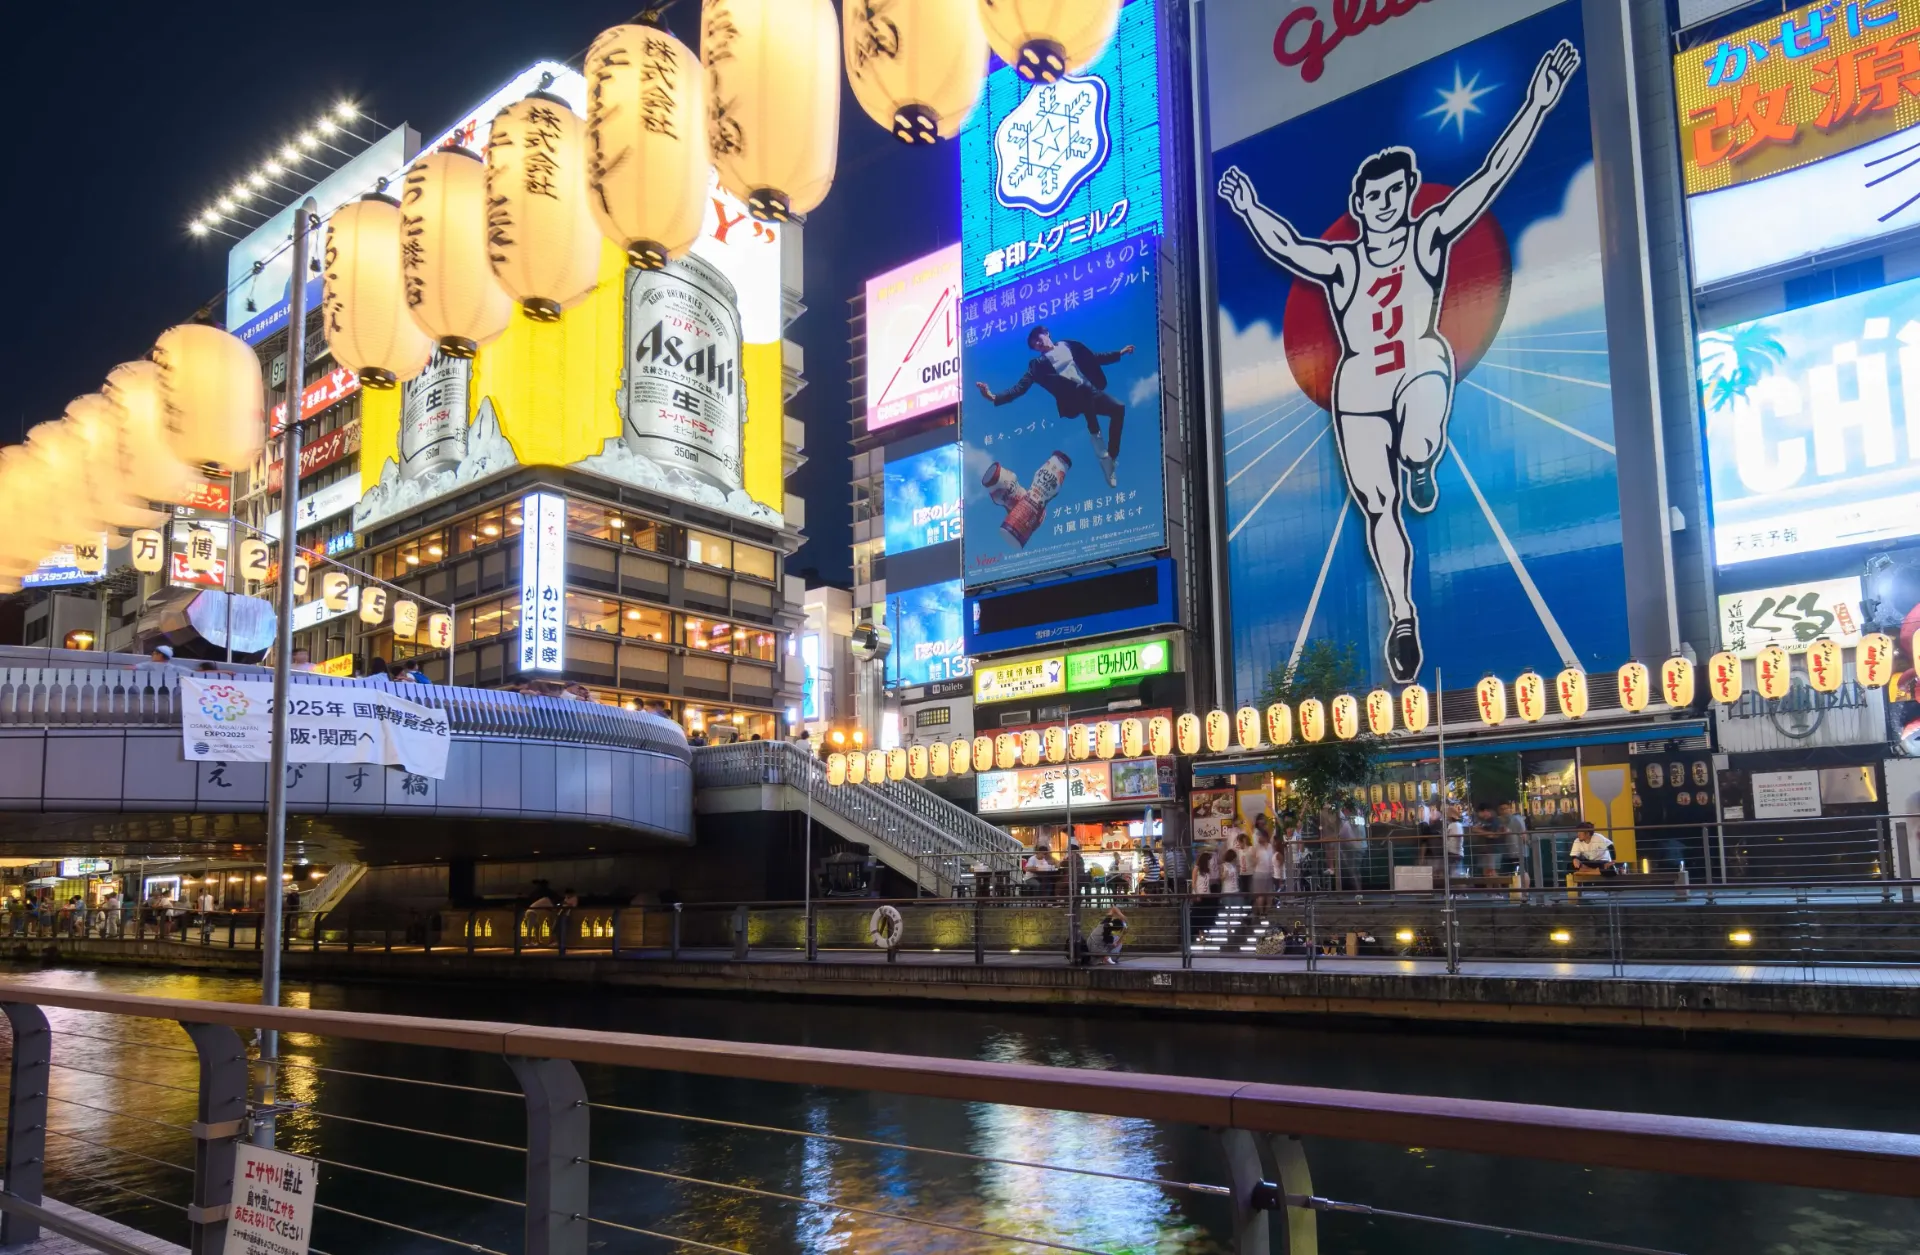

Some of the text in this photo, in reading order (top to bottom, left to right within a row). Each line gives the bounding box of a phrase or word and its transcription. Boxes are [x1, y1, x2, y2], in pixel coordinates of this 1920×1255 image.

[1703, 0, 1899, 87] かぜに
[641, 37, 680, 140] 株式会社
[1688, 28, 1920, 168] 改源
[526, 106, 561, 200] 株式会社
[983, 199, 1130, 276] 雪印メグミルク
[964, 239, 1150, 323] 道頓堀のおいしいものと
[704, 308, 724, 337] LIMITED
[1367, 265, 1406, 377] グリコ
[273, 361, 285, 382] 9F
[636, 319, 733, 397] Asahi
[922, 356, 961, 384] CNCO
[426, 389, 443, 413] 生
[673, 389, 701, 416] 生
[658, 409, 715, 437] スーパードライ
[299, 434, 342, 476] ダイニング
[674, 446, 699, 463] 350ml
[1052, 490, 1137, 519] ガセリ菌SP株が
[1053, 506, 1144, 536] 内臓脂肪を減らす
[1732, 527, 1799, 552] 天気予報
[136, 538, 158, 559] 万
[192, 537, 213, 560] 博
[250, 548, 266, 569] 2
[335, 581, 349, 600] 2
[373, 595, 386, 616] 5
[542, 585, 558, 664] かに道楽
[1746, 591, 1835, 642] くくる
[1035, 624, 1083, 640] 雪印メグミルク
[1097, 650, 1139, 676] ピタットハウス
[941, 682, 964, 693] Toilets
[353, 702, 449, 737] 国際博覧会を
[267, 727, 375, 747] 阪・関西へ
[1041, 779, 1085, 800] 壱番
[245, 1160, 303, 1195] エサやり禁止
[246, 1190, 295, 1220] 鳥や魚にエサを
[234, 1206, 304, 1242] あたえないでください
